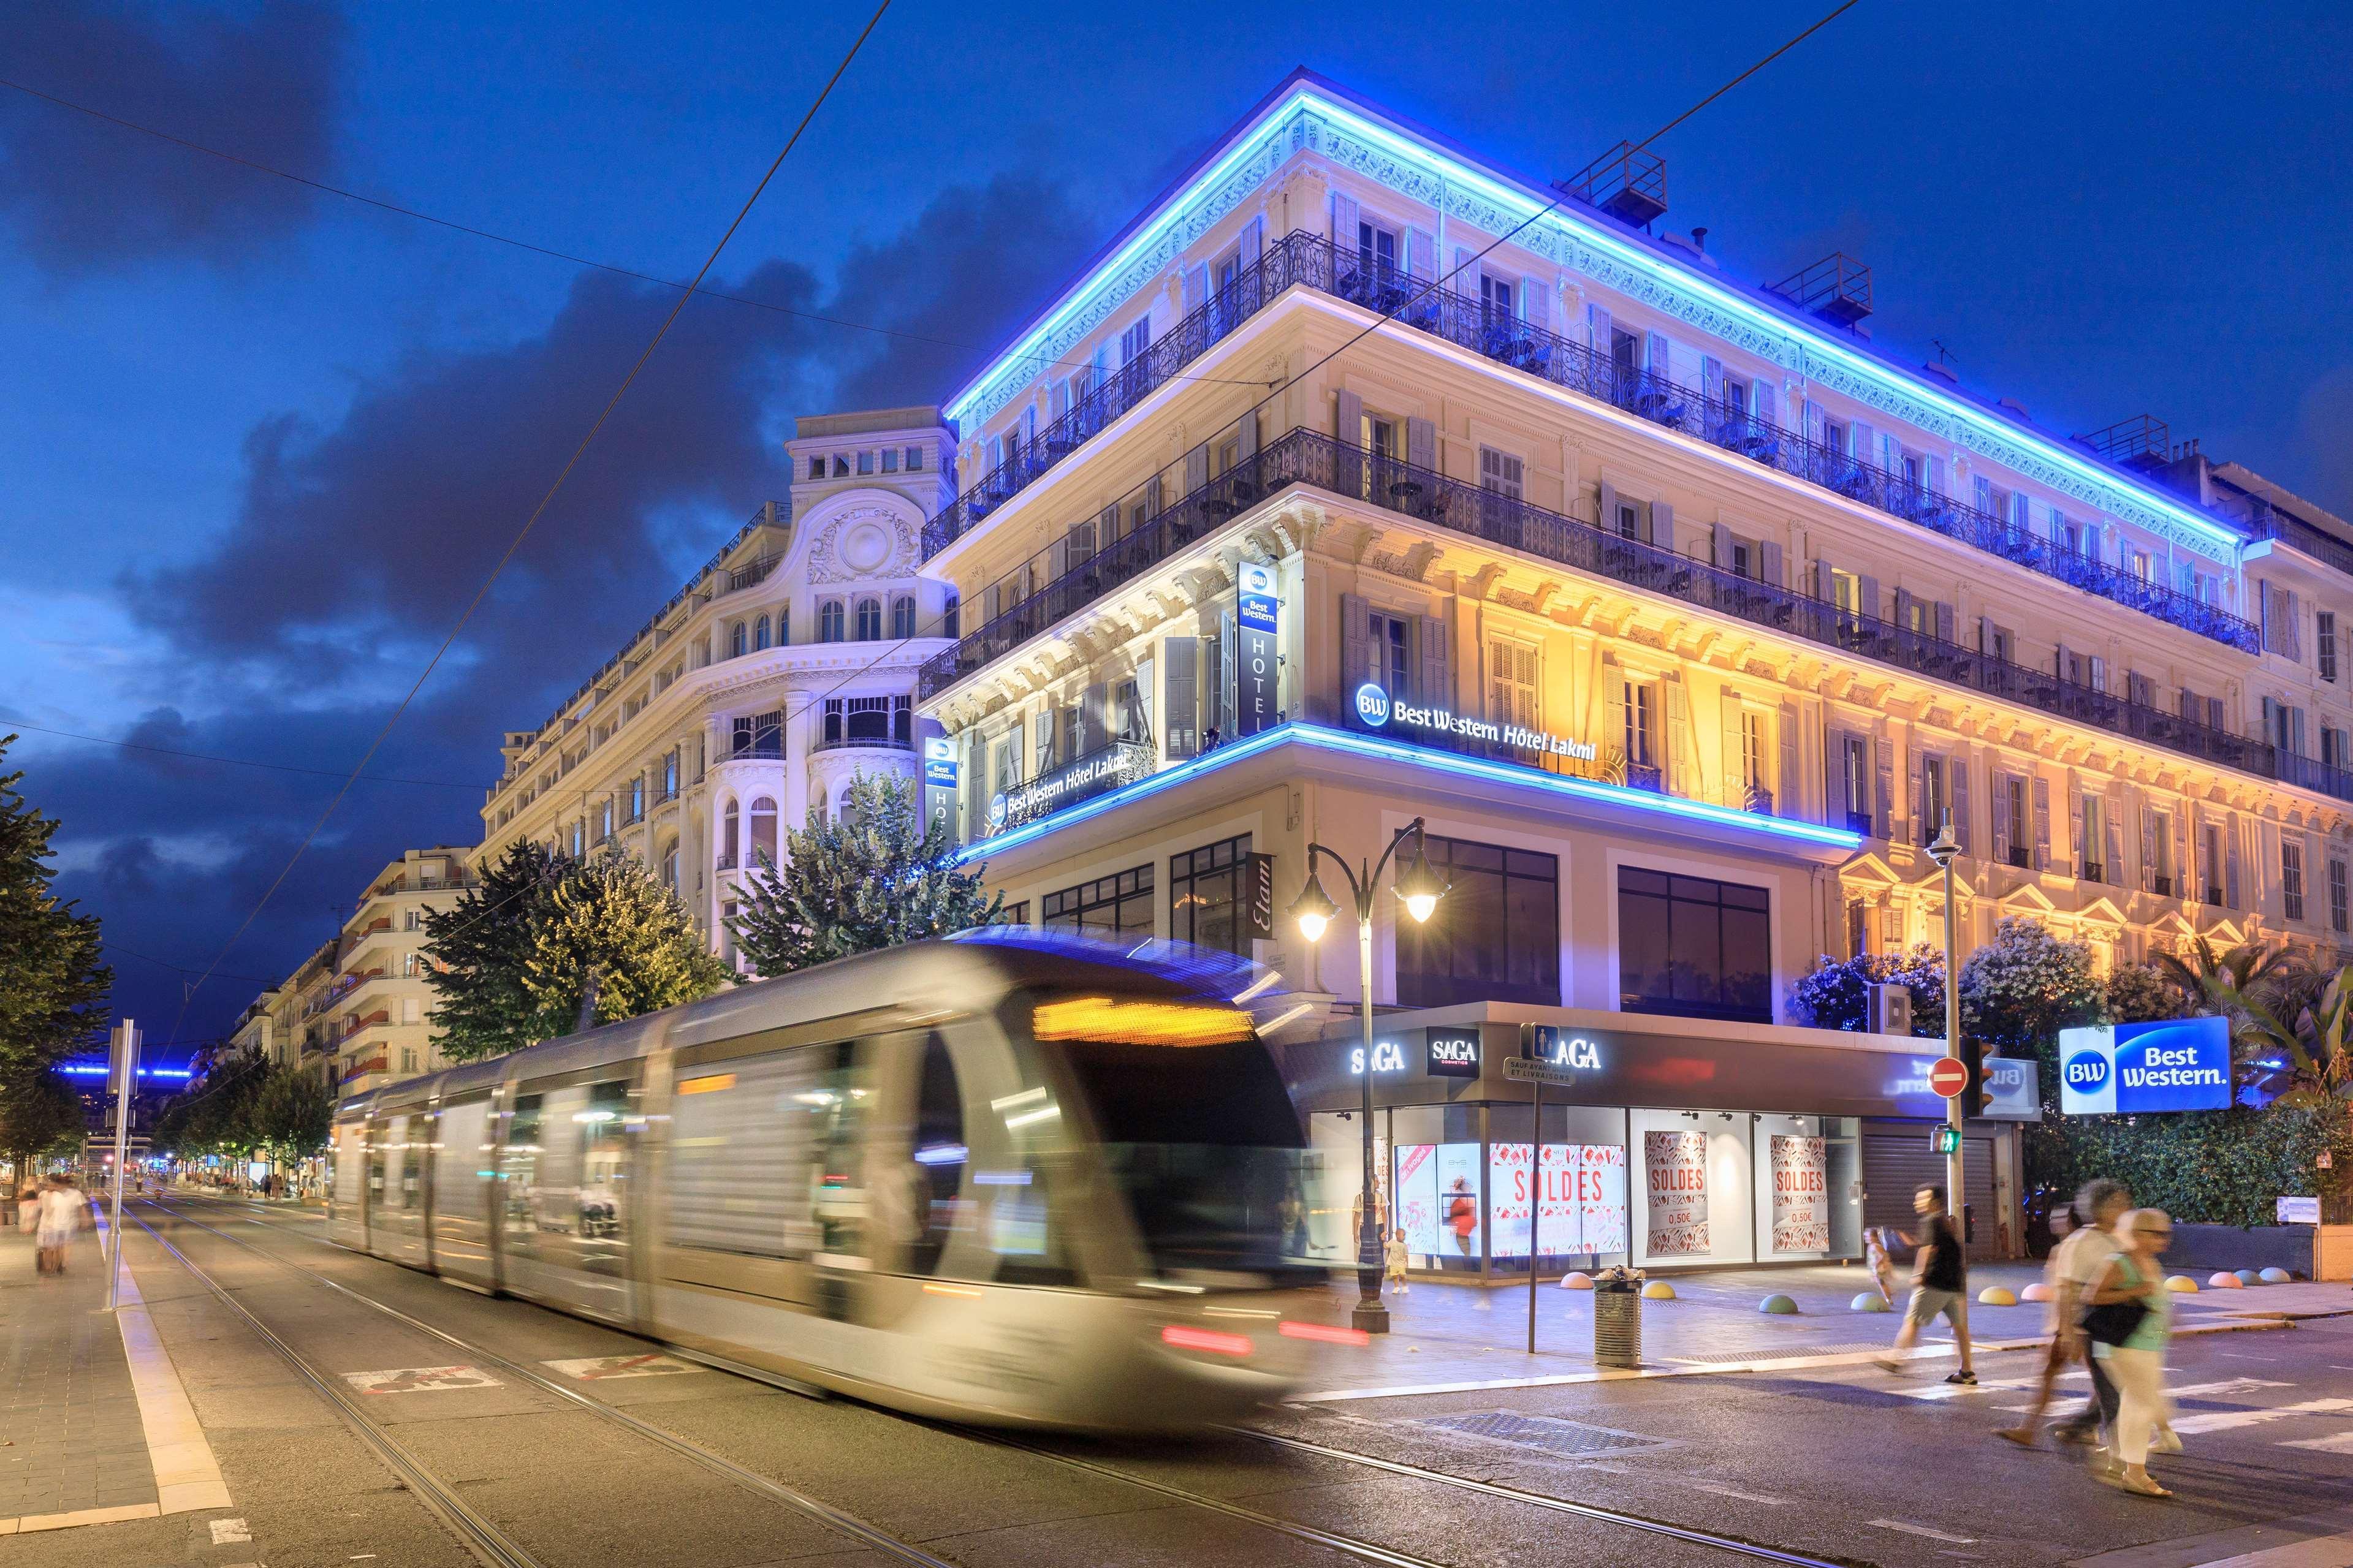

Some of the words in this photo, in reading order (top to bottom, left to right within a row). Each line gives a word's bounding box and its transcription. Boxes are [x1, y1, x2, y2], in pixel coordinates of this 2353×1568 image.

[1252, 574, 1266, 586] BW
[1250, 600, 1268, 613] Best
[1252, 637, 1265, 733] HOTEL
[1360, 695, 1386, 716] BW
[1394, 701, 1432, 727] Best
[1433, 709, 1499, 741] Western
[1503, 725, 1547, 751] Hôtel
[1549, 735, 1597, 761] Lakmi
[933, 765, 949, 774] Best
[992, 804, 1004, 820] BW
[1008, 794, 1027, 814] Best
[1026, 779, 1064, 806] Western
[1066, 763, 1094, 790] Hôtel
[1095, 748, 1128, 778] Lakmi
[1253, 860, 1271, 931] Etam
[1351, 1042, 1405, 1074] SGA
[1433, 1040, 1477, 1061] SAGA
[1554, 1039, 1602, 1069] AGA
[2145, 1047, 2198, 1067] Best
[1522, 1070, 1570, 1081] LIVRAISONS
[2069, 1062, 2106, 1083] BW
[1515, 1170, 1602, 1202] SOLDES
[1652, 1168, 1703, 1191] SOLDES
[1776, 1171, 1823, 1192] SOLDES
[1668, 1212, 1692, 1225] 0,50€
[1792, 1212, 1812, 1224] 0,50€
